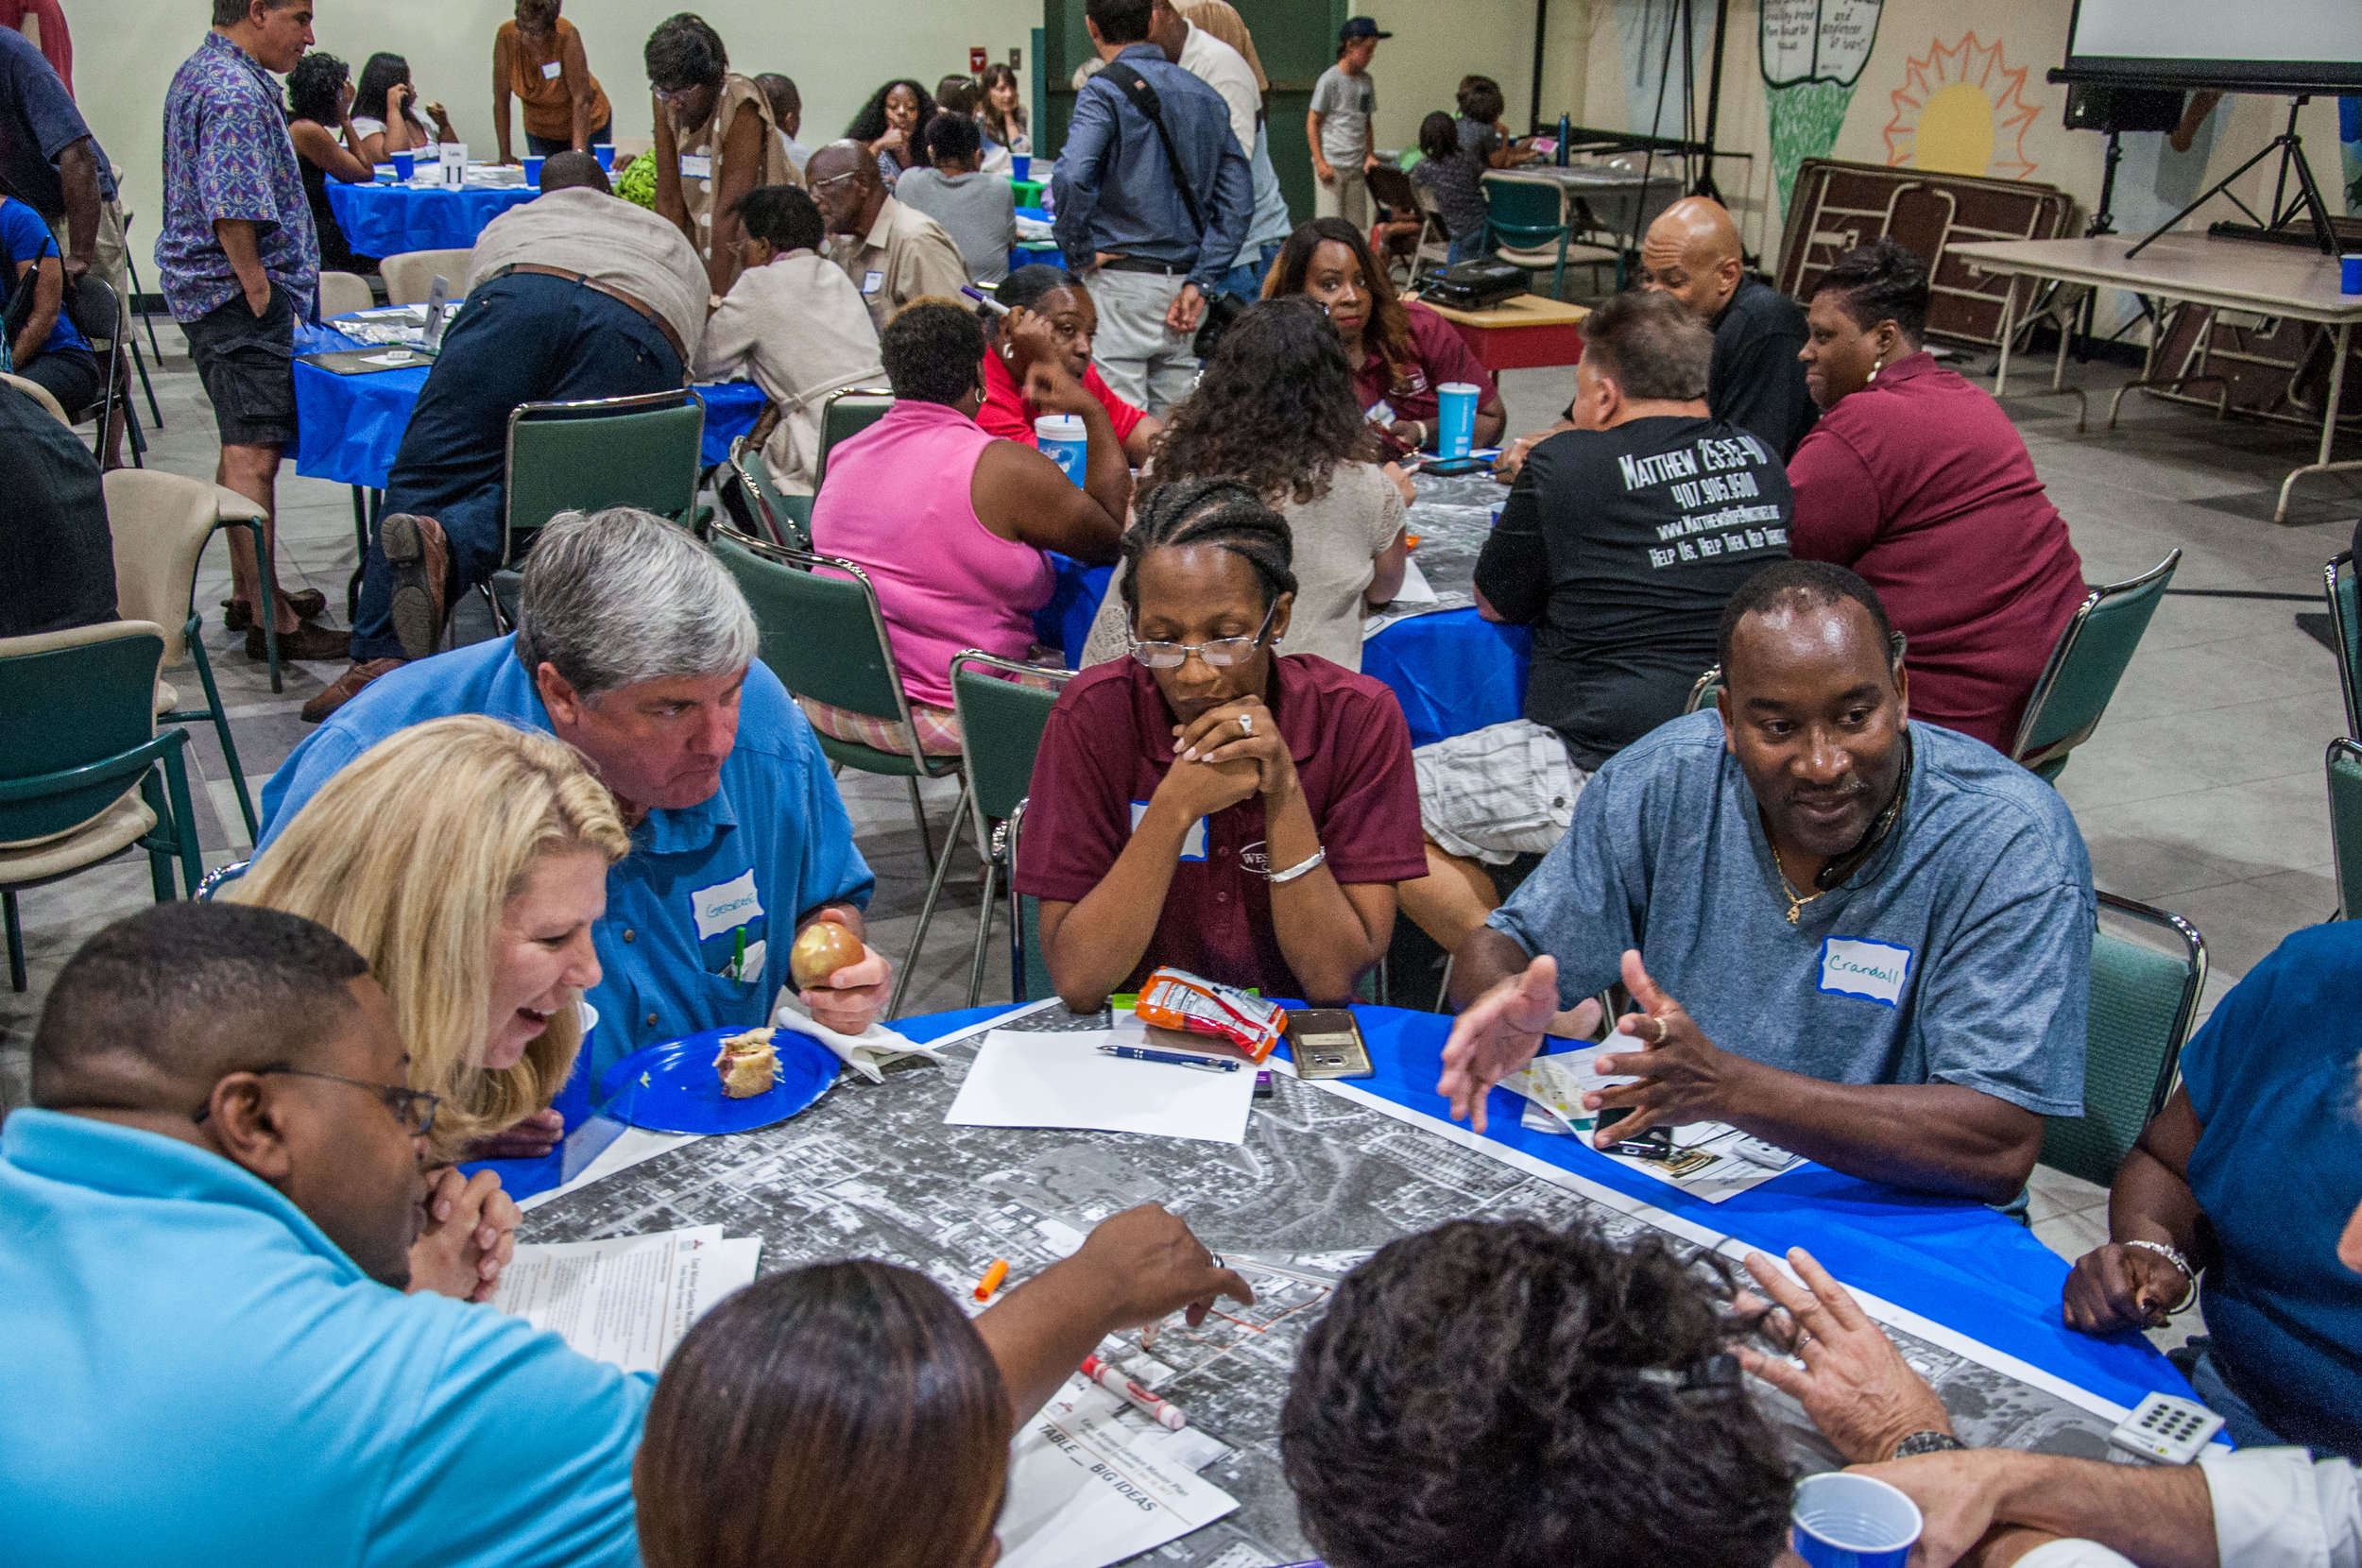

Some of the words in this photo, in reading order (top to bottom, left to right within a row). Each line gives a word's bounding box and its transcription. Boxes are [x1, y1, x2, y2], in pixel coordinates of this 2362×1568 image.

[445, 165, 462, 184] 11
[1618, 449, 1699, 490] MATTHEW
[1670, 471, 1759, 510] 407.905.9500
[1648, 548, 1676, 569] HELP
[1697, 537, 1722, 557] HELP
[1242, 853, 1269, 863] WES
[1829, 954, 1899, 985] Crandall
[1037, 1423, 1080, 1455] TABLE
[1089, 1463, 1118, 1482] BIG
[1113, 1480, 1157, 1511] IDEAS
